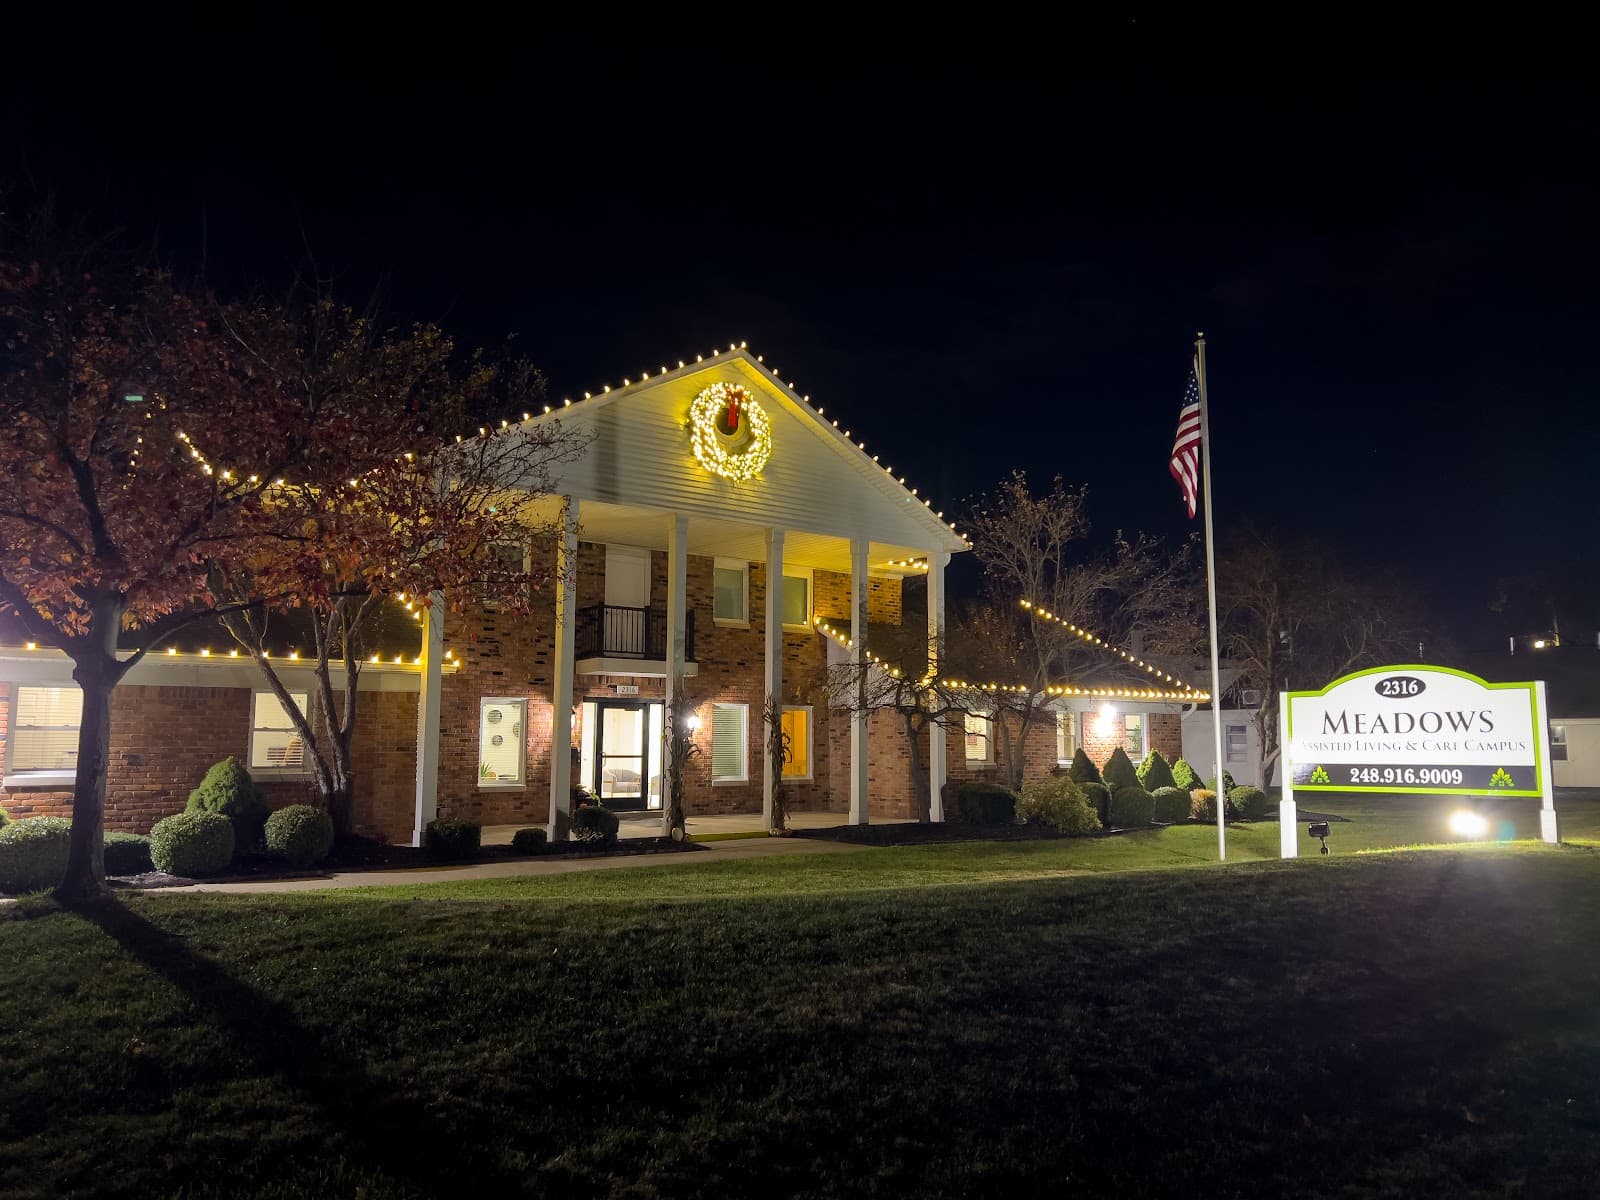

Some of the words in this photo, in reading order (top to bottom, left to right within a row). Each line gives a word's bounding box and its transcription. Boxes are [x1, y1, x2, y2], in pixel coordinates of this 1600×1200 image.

[1382, 680, 1419, 695] 2316
[1321, 709, 1495, 735] MEADOWS
[1355, 739, 1401, 752] LIVING
[1405, 740, 1418, 752] &
[1422, 739, 1458, 752] CARE
[1464, 739, 1527, 752] CAMPUS
[1350, 767, 1463, 785] 248.916.9009
